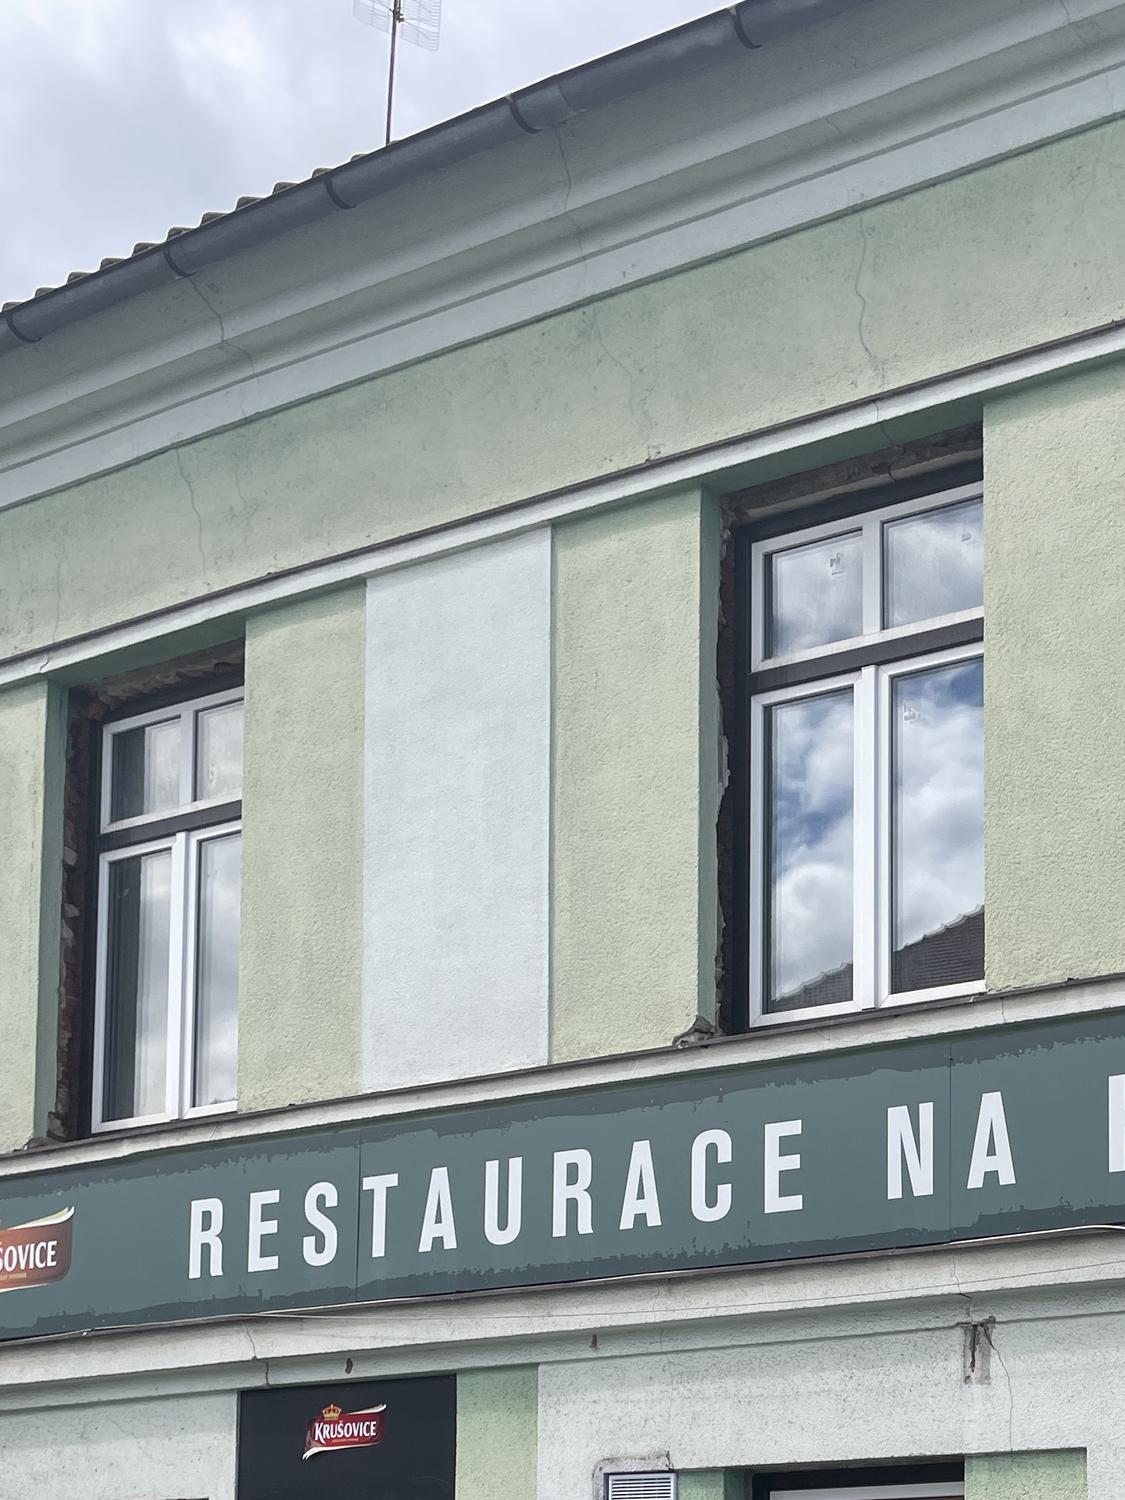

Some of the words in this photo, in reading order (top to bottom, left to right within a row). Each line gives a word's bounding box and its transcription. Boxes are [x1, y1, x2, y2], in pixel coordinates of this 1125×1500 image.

[188, 1119, 803, 1279] RESTAURACE
[887, 1091, 1016, 1200] NA
[0, 1240, 58, 1272] OVICE
[314, 1420, 377, 1444] KRUŠOVICE
